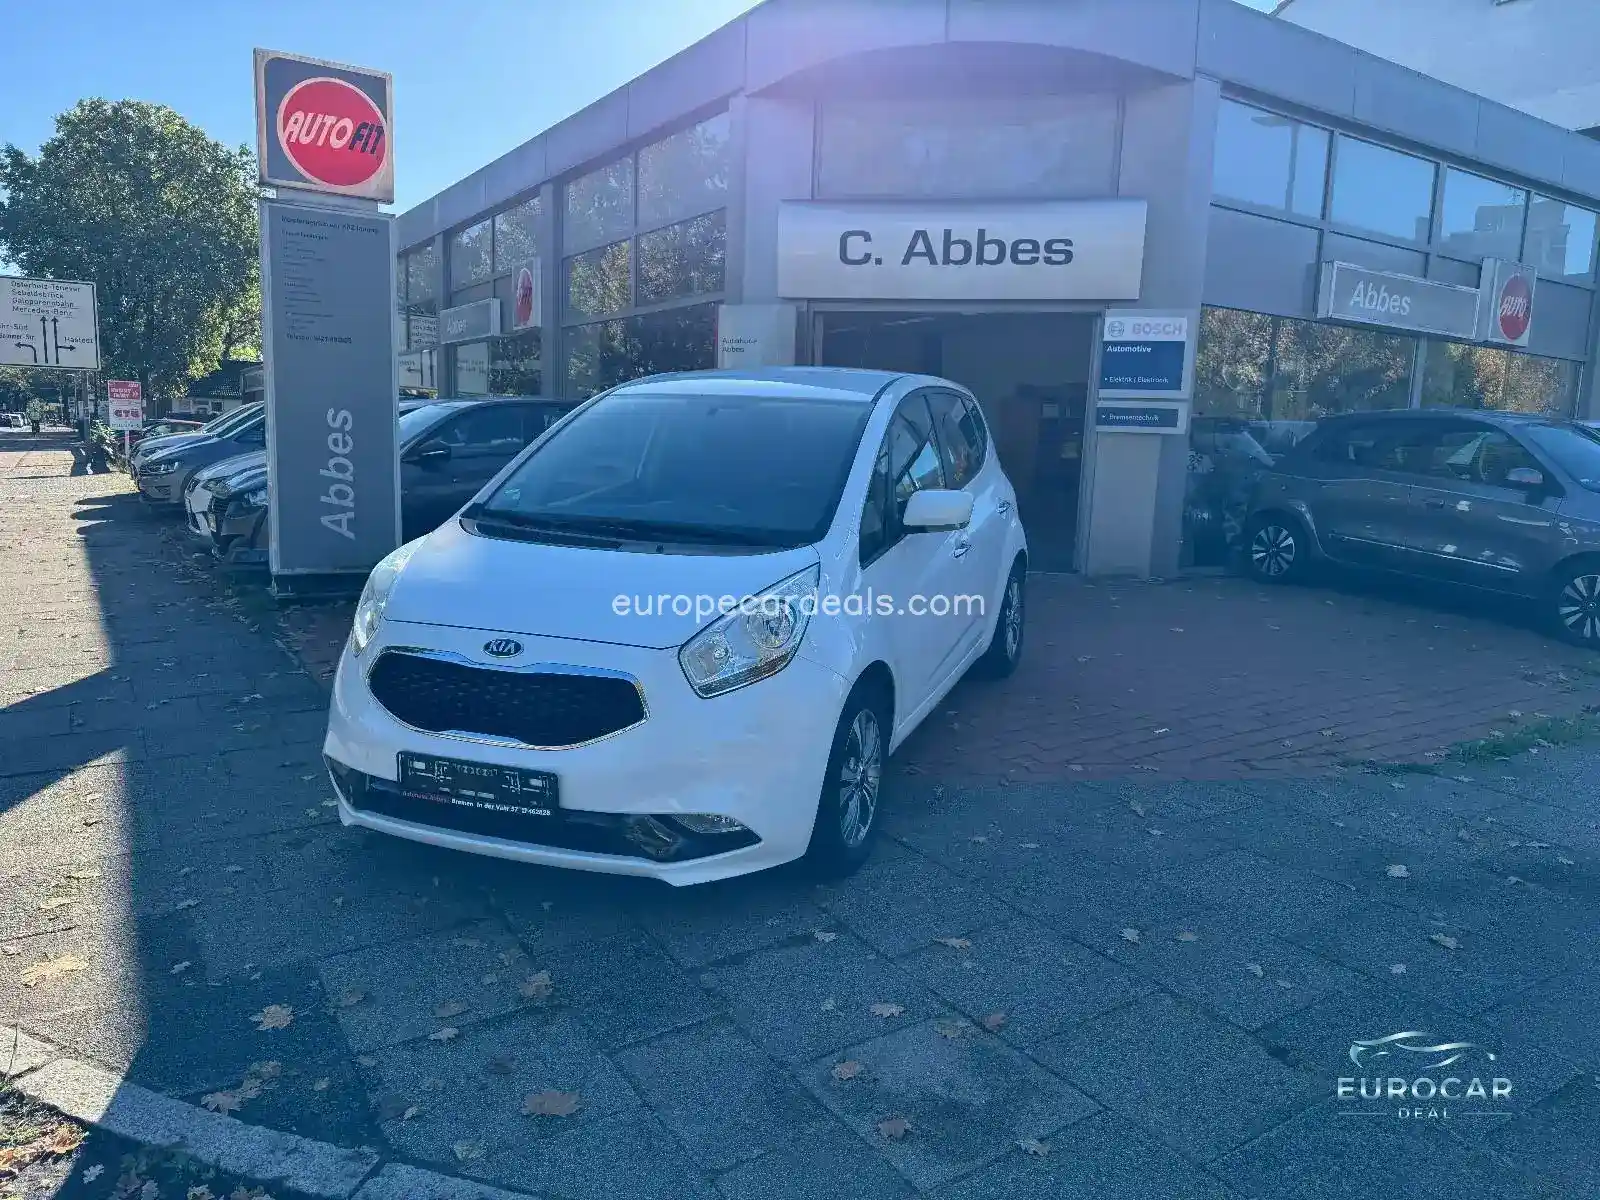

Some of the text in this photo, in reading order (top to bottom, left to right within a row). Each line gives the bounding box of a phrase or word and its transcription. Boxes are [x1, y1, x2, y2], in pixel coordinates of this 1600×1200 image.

[839, 228, 1074, 266] C. Abbes
[1350, 280, 1411, 316] Abbes
[1132, 322, 1183, 335] BOSCH
[1106, 345, 1152, 353] Automotive
[319, 407, 356, 541] Abbes
[489, 640, 515, 654] KIA
[452, 798, 474, 808] Bremen
